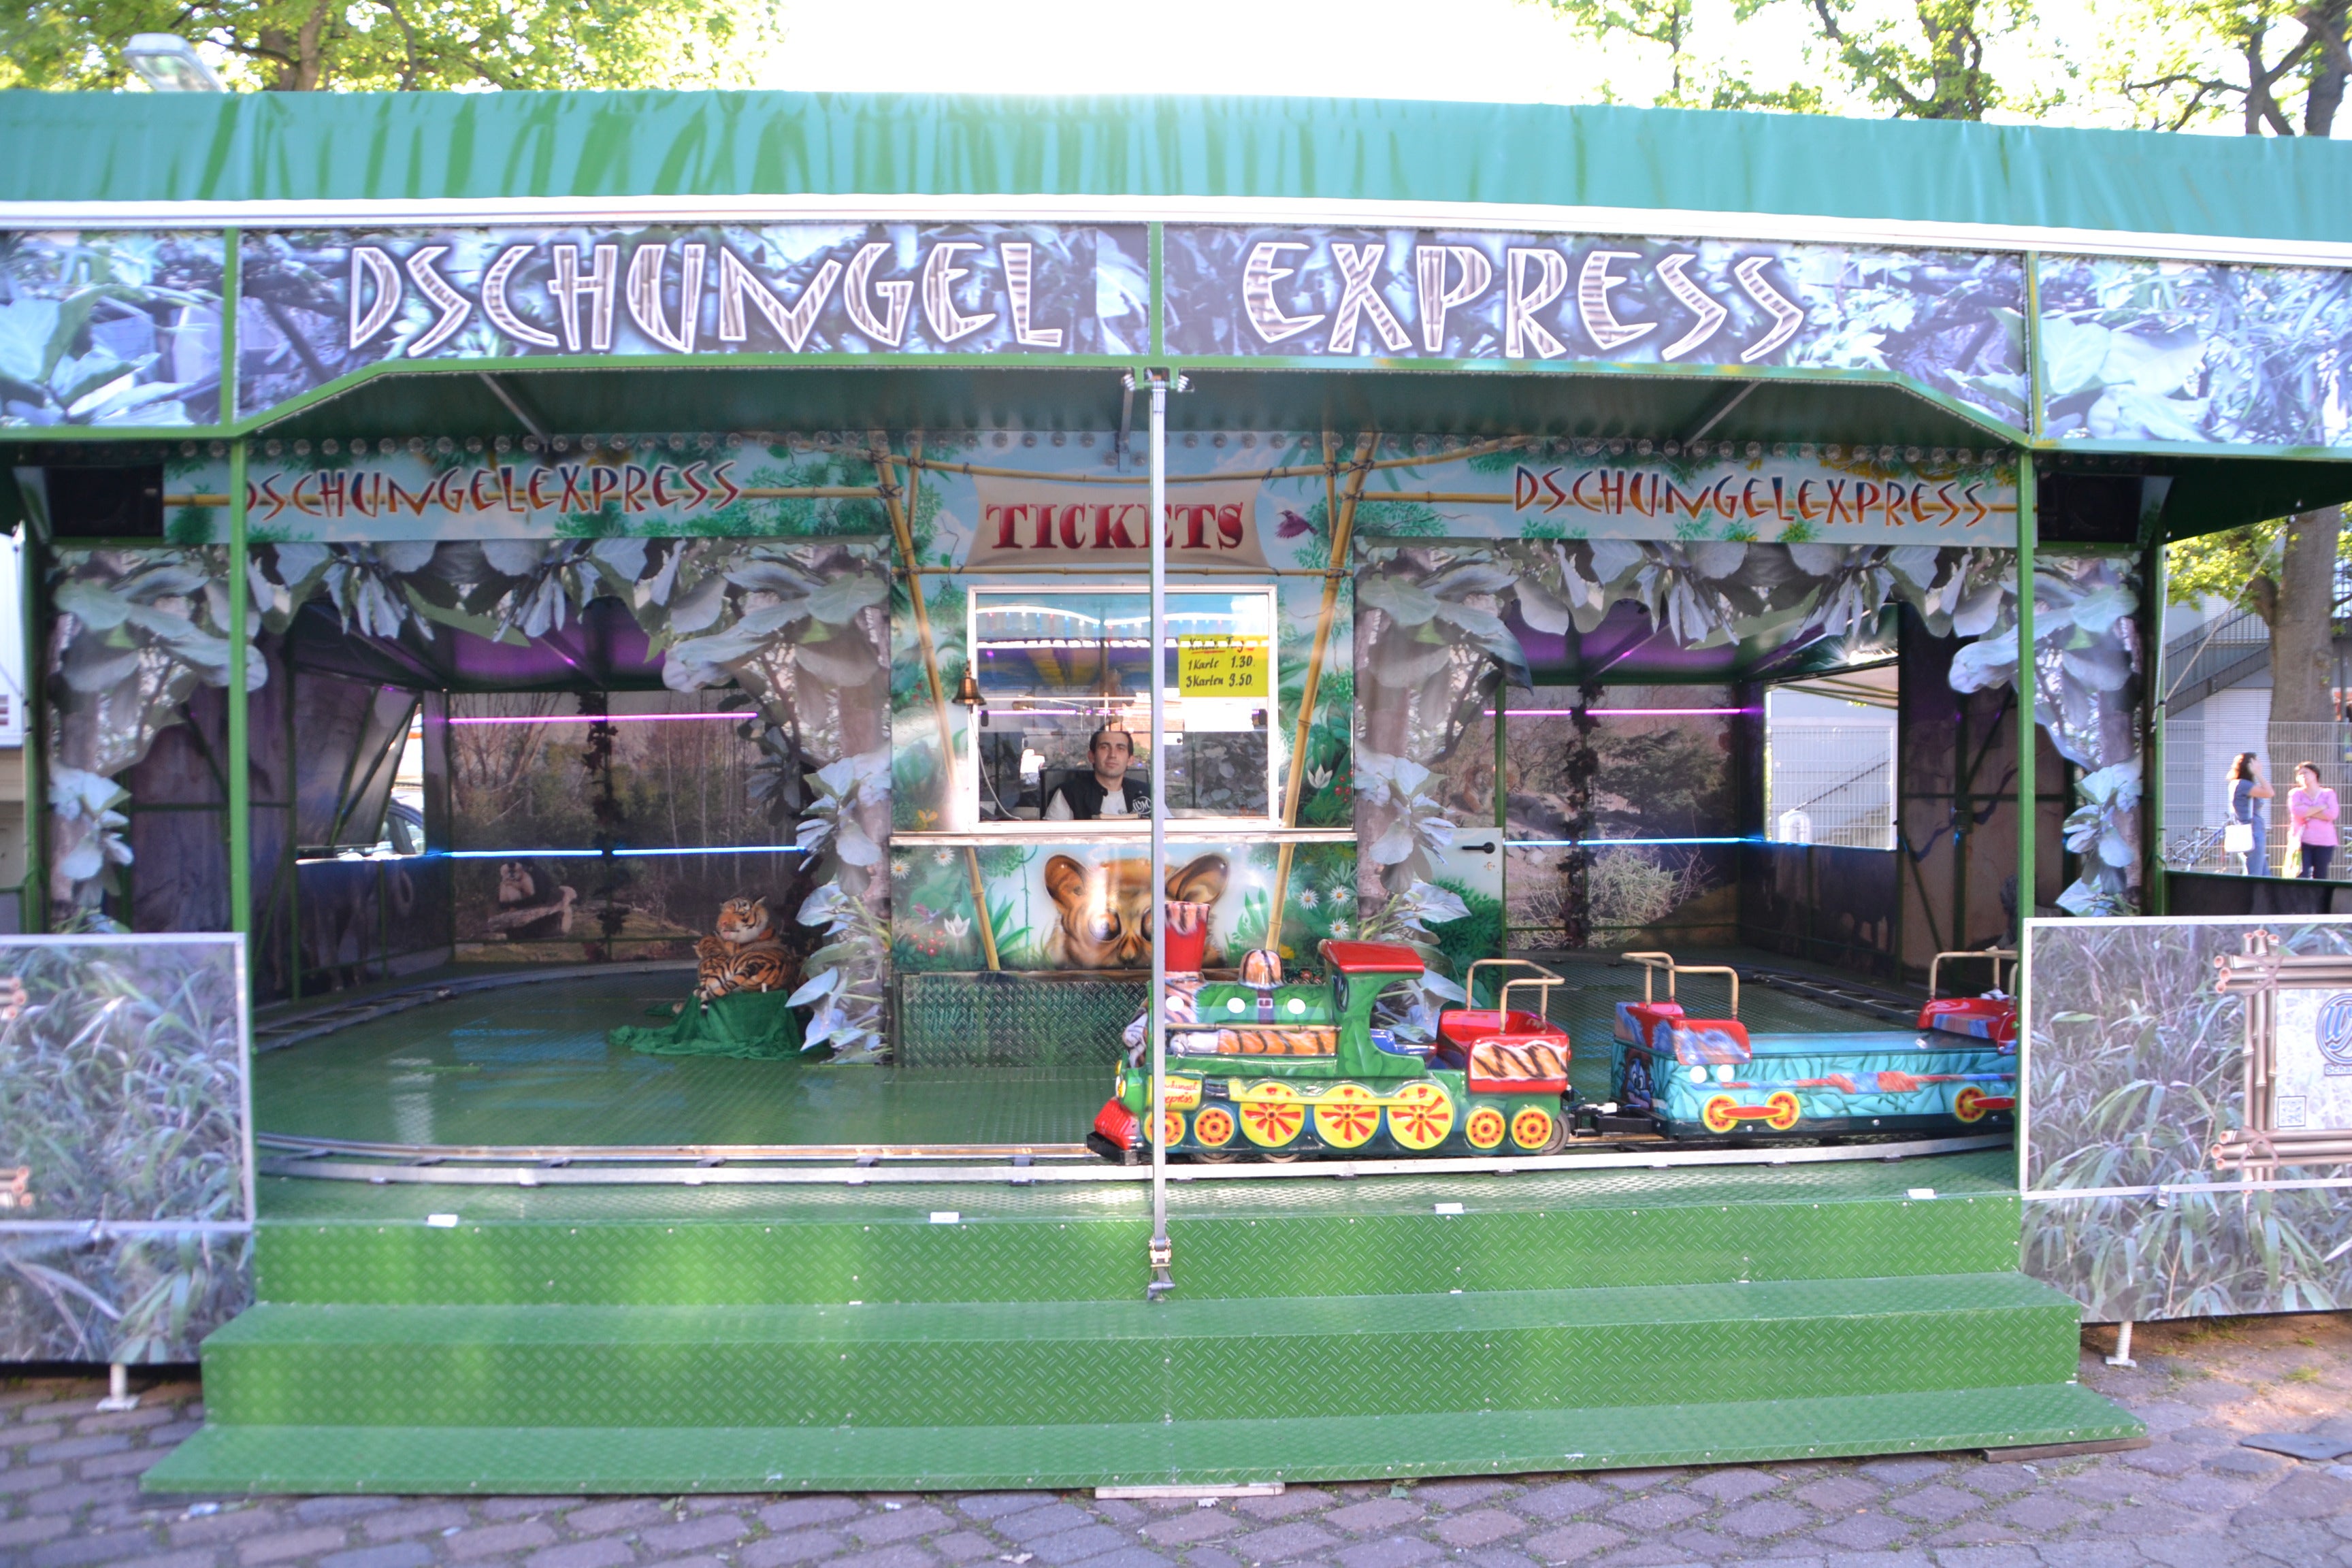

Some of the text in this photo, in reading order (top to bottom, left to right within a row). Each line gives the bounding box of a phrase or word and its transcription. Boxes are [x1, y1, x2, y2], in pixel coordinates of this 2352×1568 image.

[350, 242, 1805, 362] DSCHUNGEL EXPRESS
[985, 501, 1244, 551] TICKETS
[1514, 464, 1991, 528] DSCHUNGELEXPRESS
